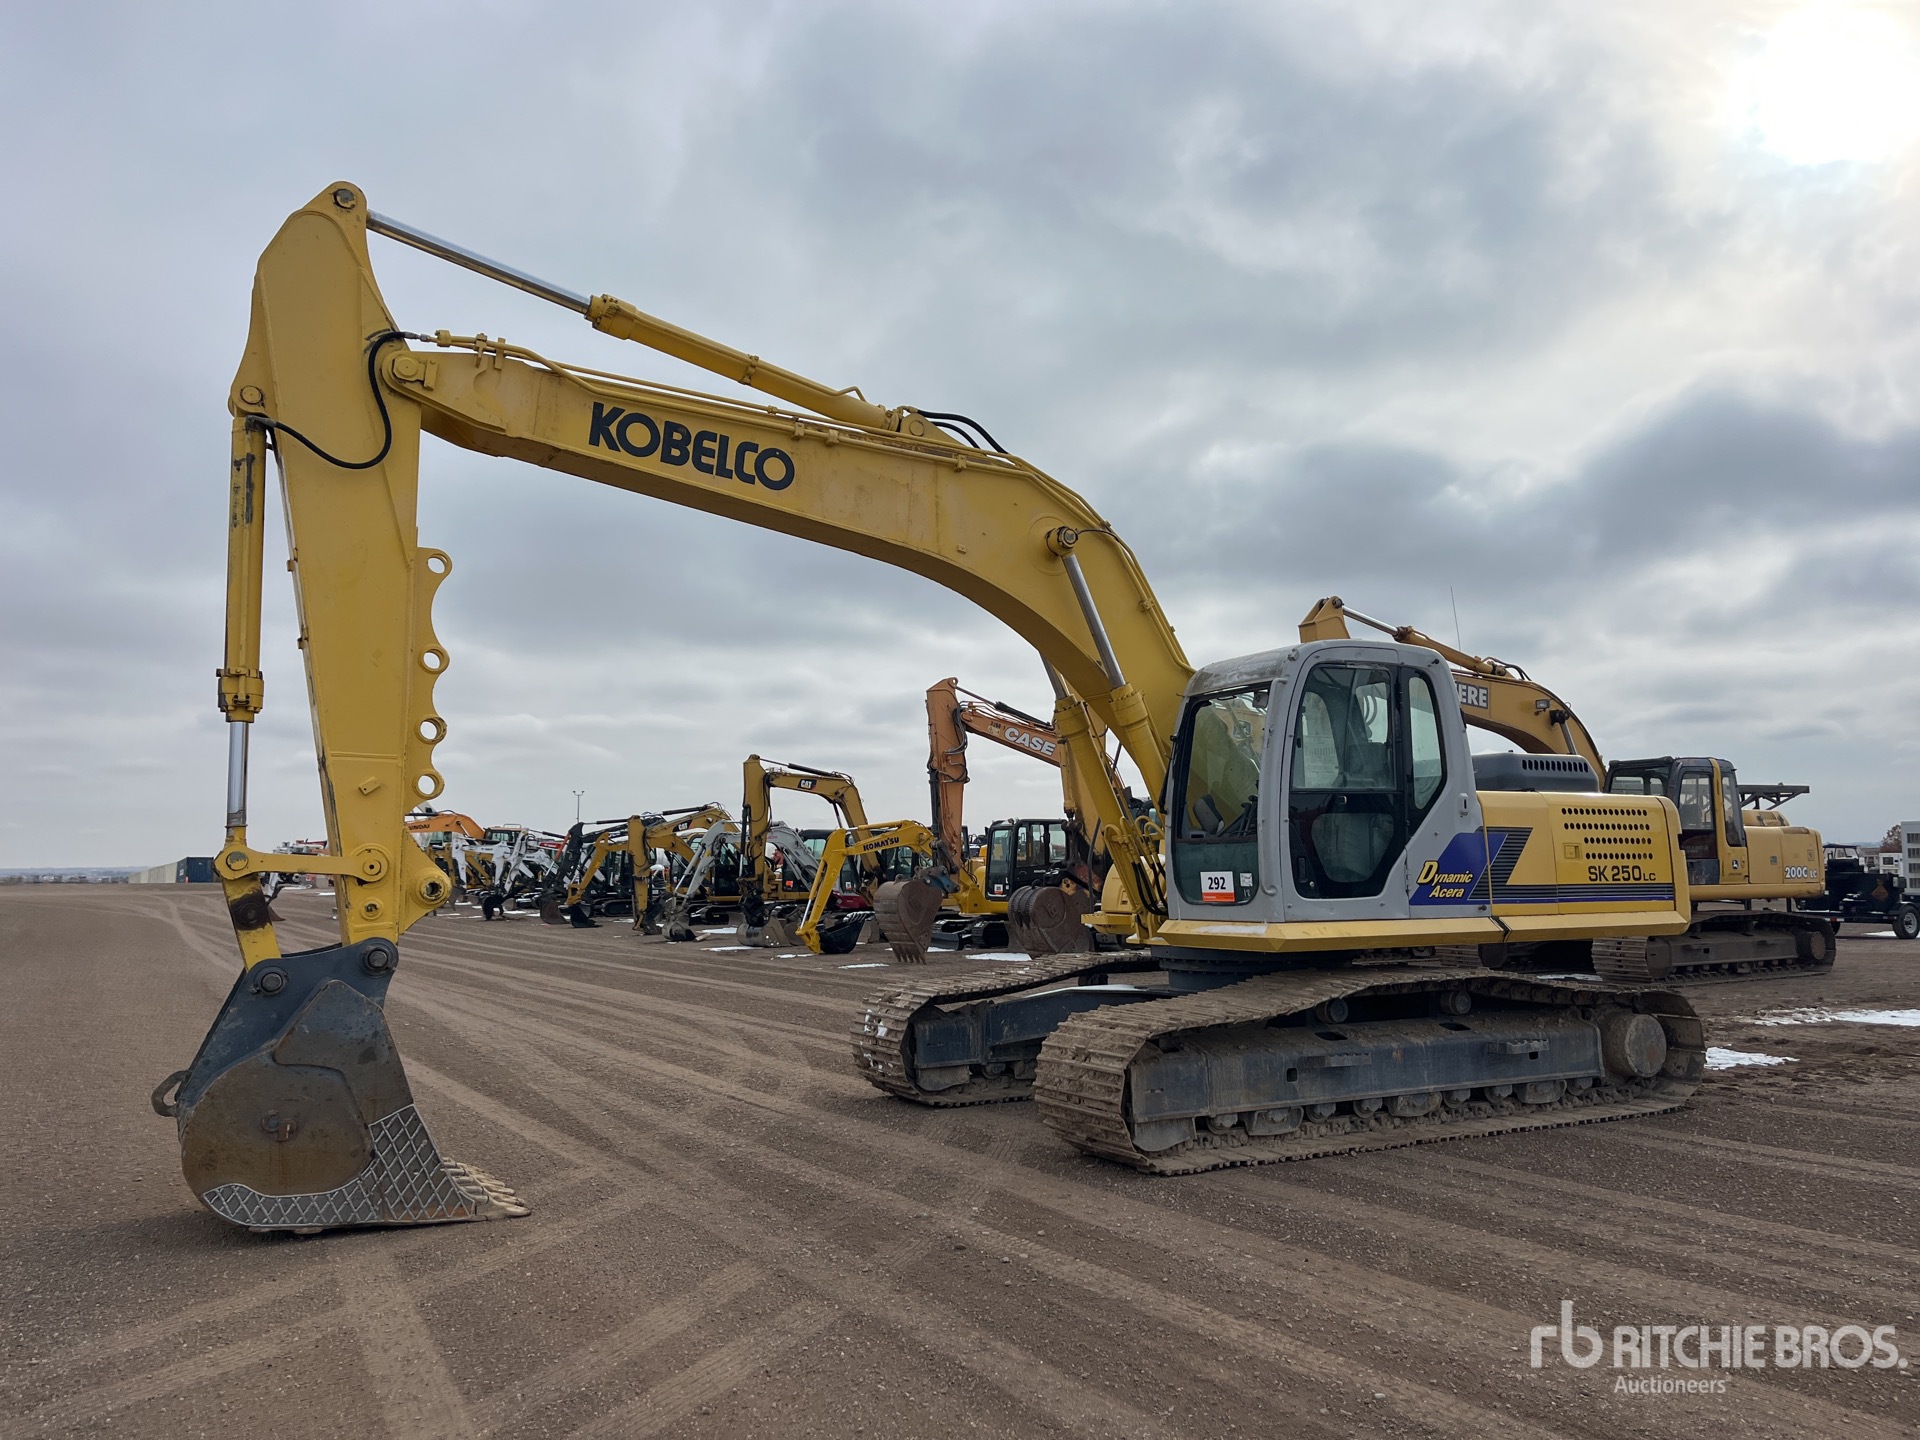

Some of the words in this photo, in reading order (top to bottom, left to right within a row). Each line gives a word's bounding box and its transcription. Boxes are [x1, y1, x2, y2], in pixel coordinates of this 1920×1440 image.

[588, 401, 795, 490] KOBELCO
[1456, 683, 1488, 708] ERE
[1004, 727, 1056, 755] CASE
[800, 779, 813, 789] CAT
[678, 823, 688, 831] CAT
[863, 836, 900, 851] KOMATSU
[1416, 860, 1474, 886] Dynamic
[1588, 865, 1609, 882] SK
[1784, 865, 1808, 880] 200C
[1809, 868, 1818, 879] LC
[1207, 876, 1227, 890] 292
[1428, 885, 1465, 898] Acera
